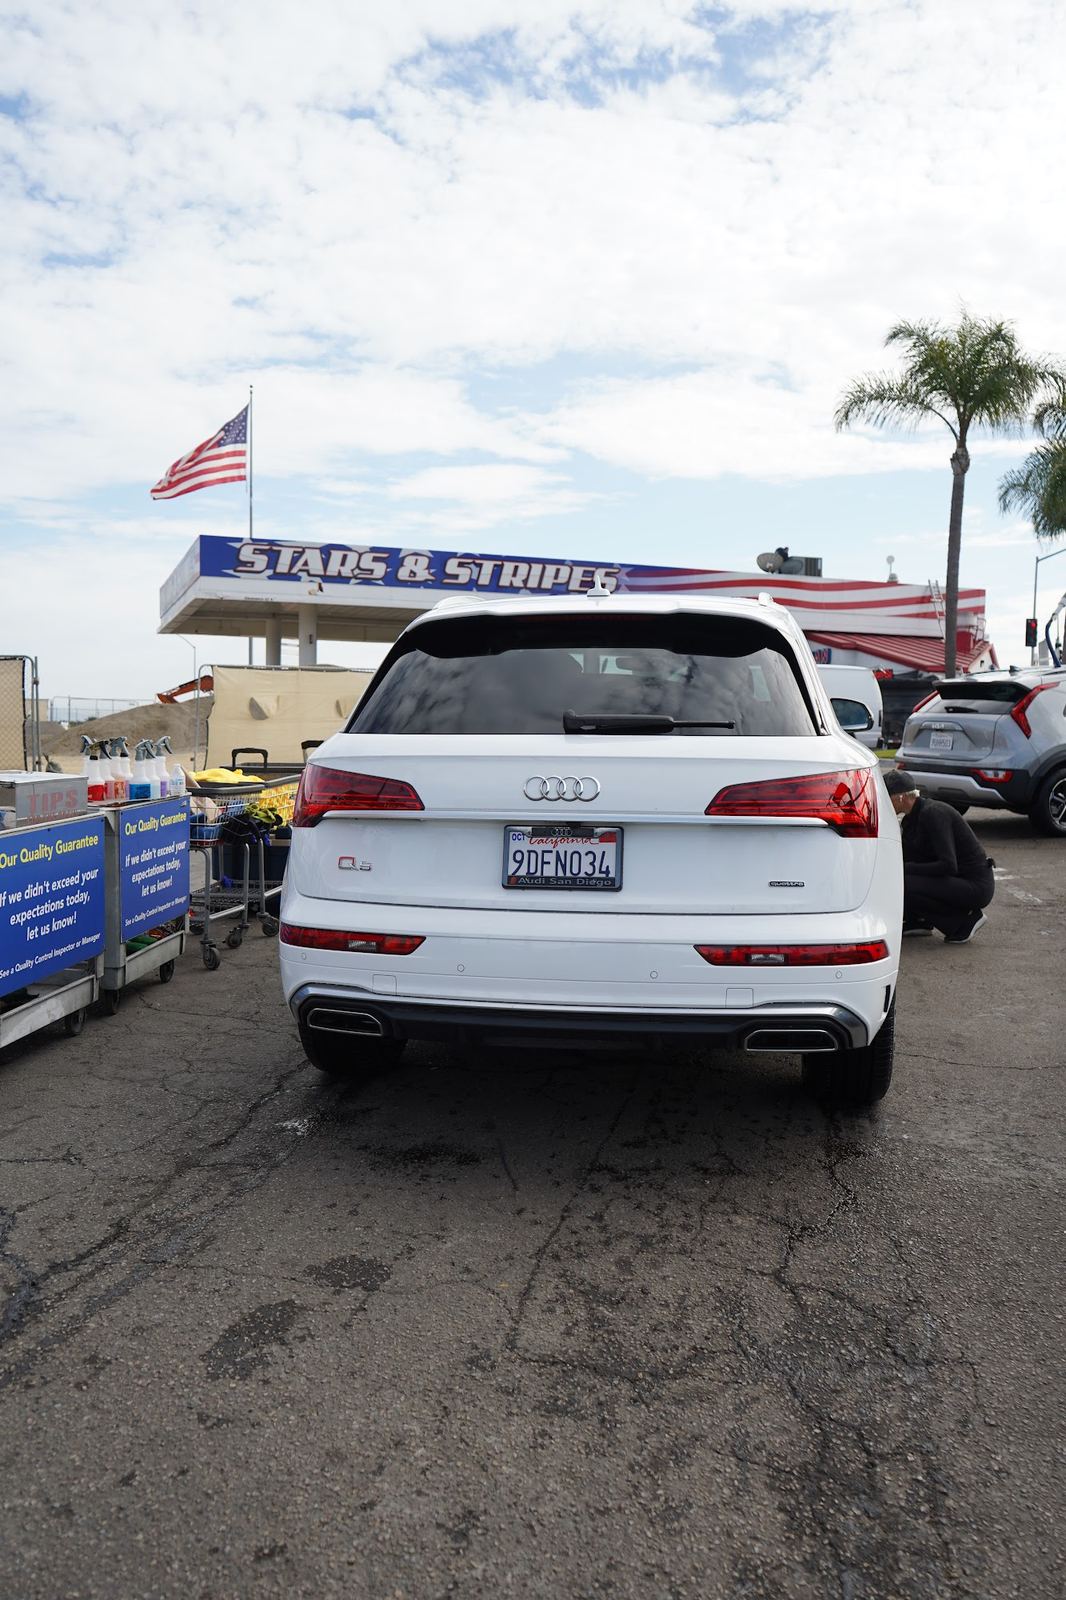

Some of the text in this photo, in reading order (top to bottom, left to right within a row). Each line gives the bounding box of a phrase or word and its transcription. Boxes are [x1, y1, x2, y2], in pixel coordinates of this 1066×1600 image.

[234, 543, 620, 594] STARS & STRIPES
[27, 789, 79, 815] TIPS
[125, 812, 187, 836] Our Quality Guarantee
[0, 834, 99, 869] Our Quality Guarantee
[131, 856, 140, 866] we
[157, 841, 175, 857] exceed
[175, 840, 187, 854] your
[511, 849, 612, 878] 9DFN034
[0, 868, 99, 907] If we didn't exceed your
[131, 863, 166, 884] expectations
[141, 875, 173, 897] let us know!
[518, 877, 612, 888] Audi San Diego
[9, 889, 91, 926] expectations today,
[26, 910, 77, 941] let us know!
[0, 968, 10, 979] See
[15, 958, 35, 972] Quality
[34, 948, 54, 965] Control
[53, 943, 76, 957] Inspector
[81, 932, 101, 945] Manager
